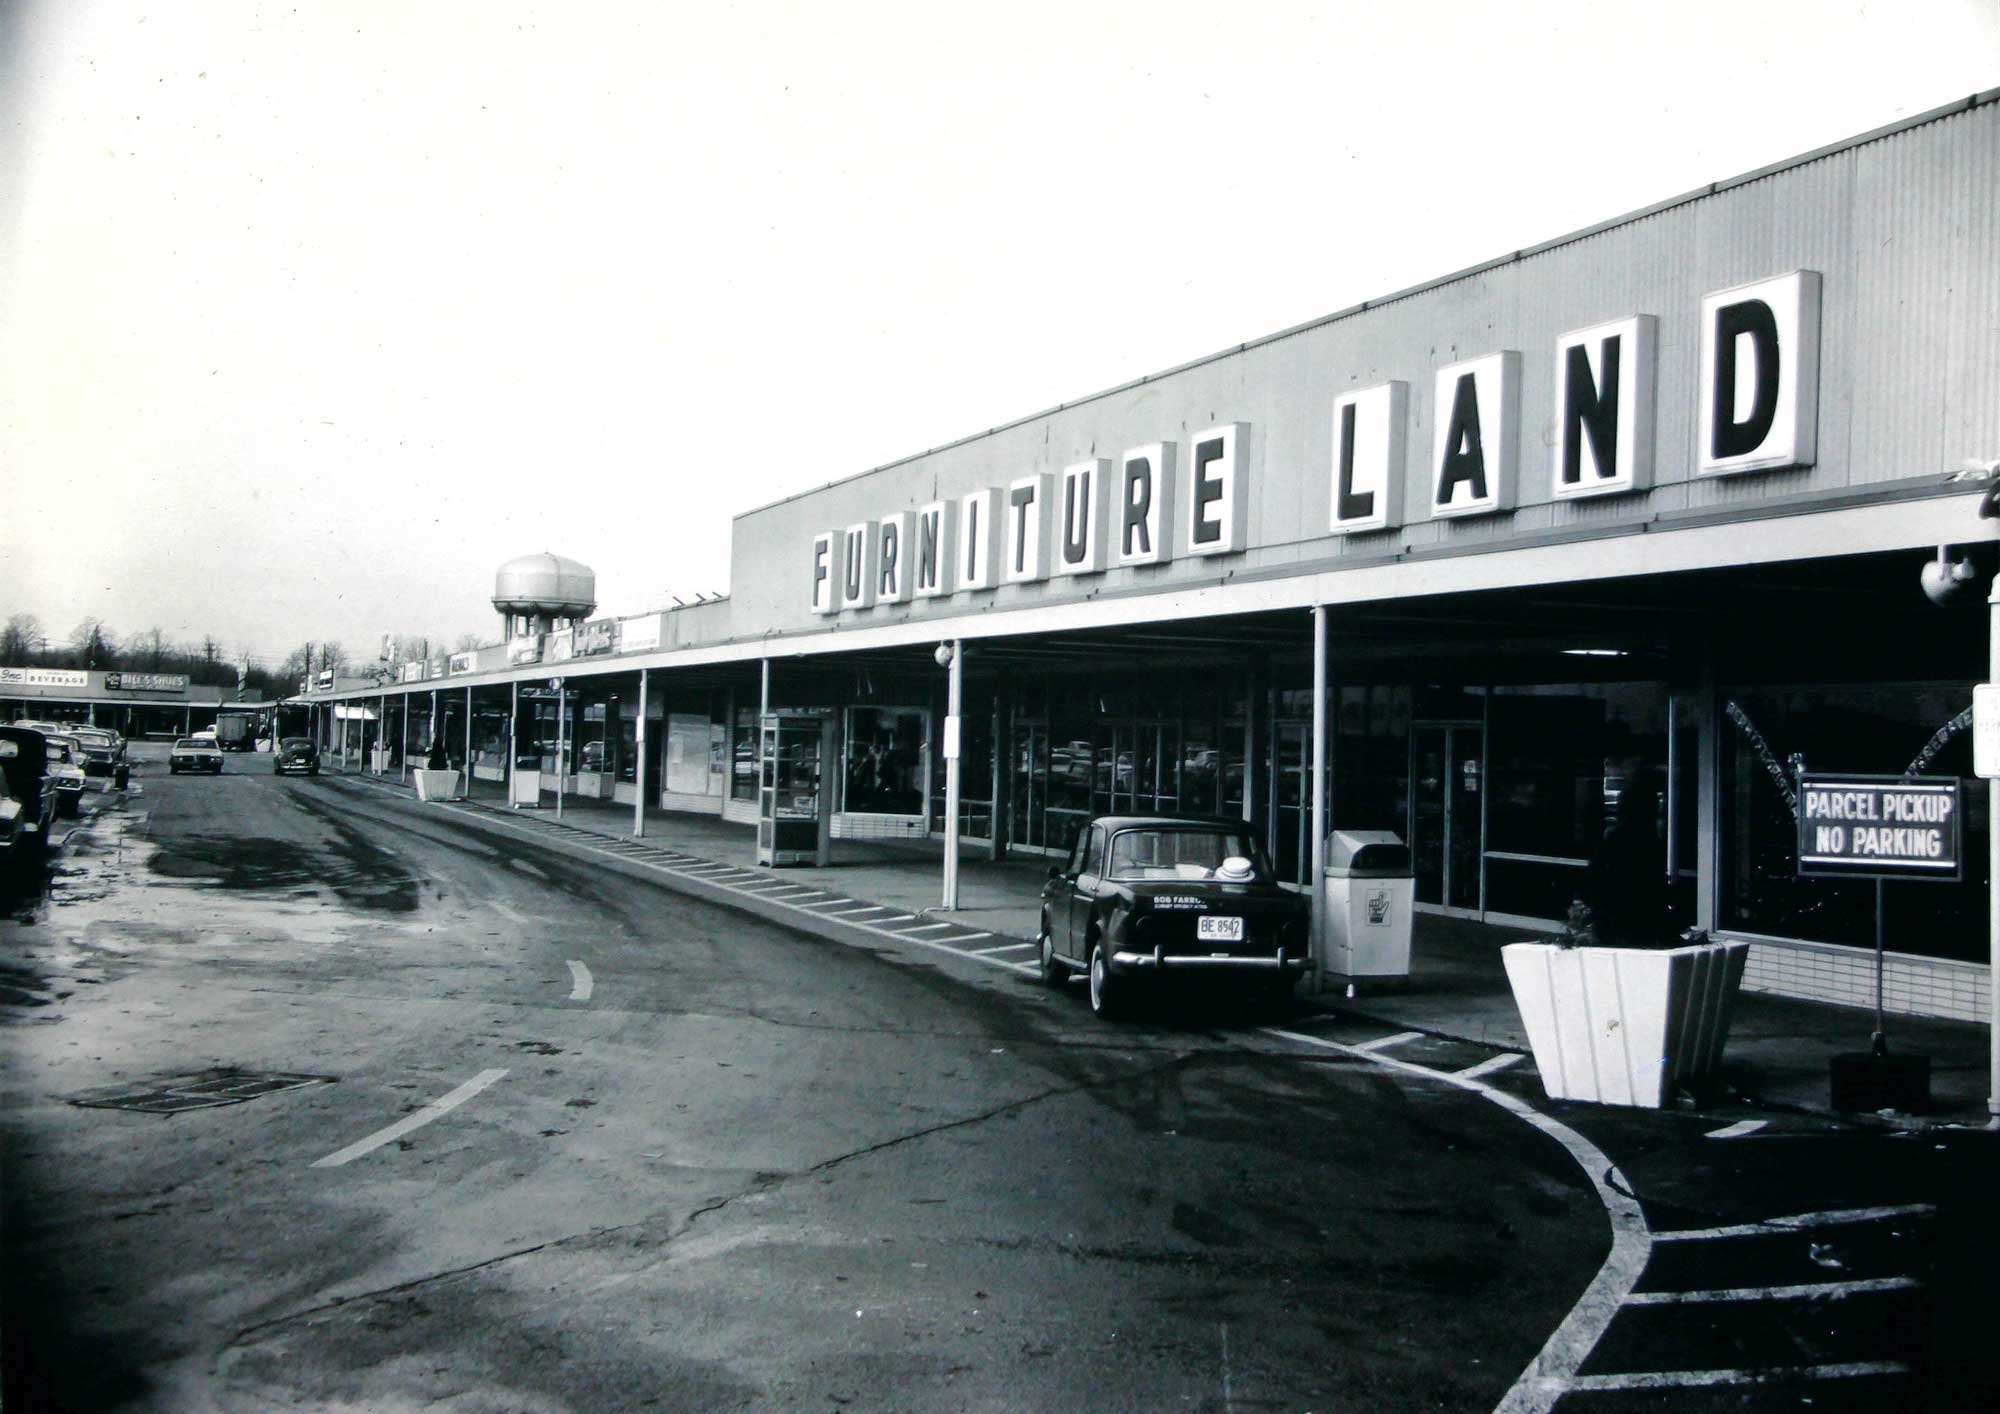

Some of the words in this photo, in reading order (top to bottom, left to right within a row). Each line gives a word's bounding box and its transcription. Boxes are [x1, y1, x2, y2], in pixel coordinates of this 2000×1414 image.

[812, 436, 1225, 608] FURNITURE
[1337, 298, 1780, 520] LAND
[30, 675, 85, 686] BEVERAGE
[1806, 791, 1879, 821] PARCEL
[1883, 793, 1951, 823] PICKUP
[1816, 825, 1844, 854] NO
[1852, 827, 1941, 858] PARKING
[1201, 919, 1215, 932] BE
